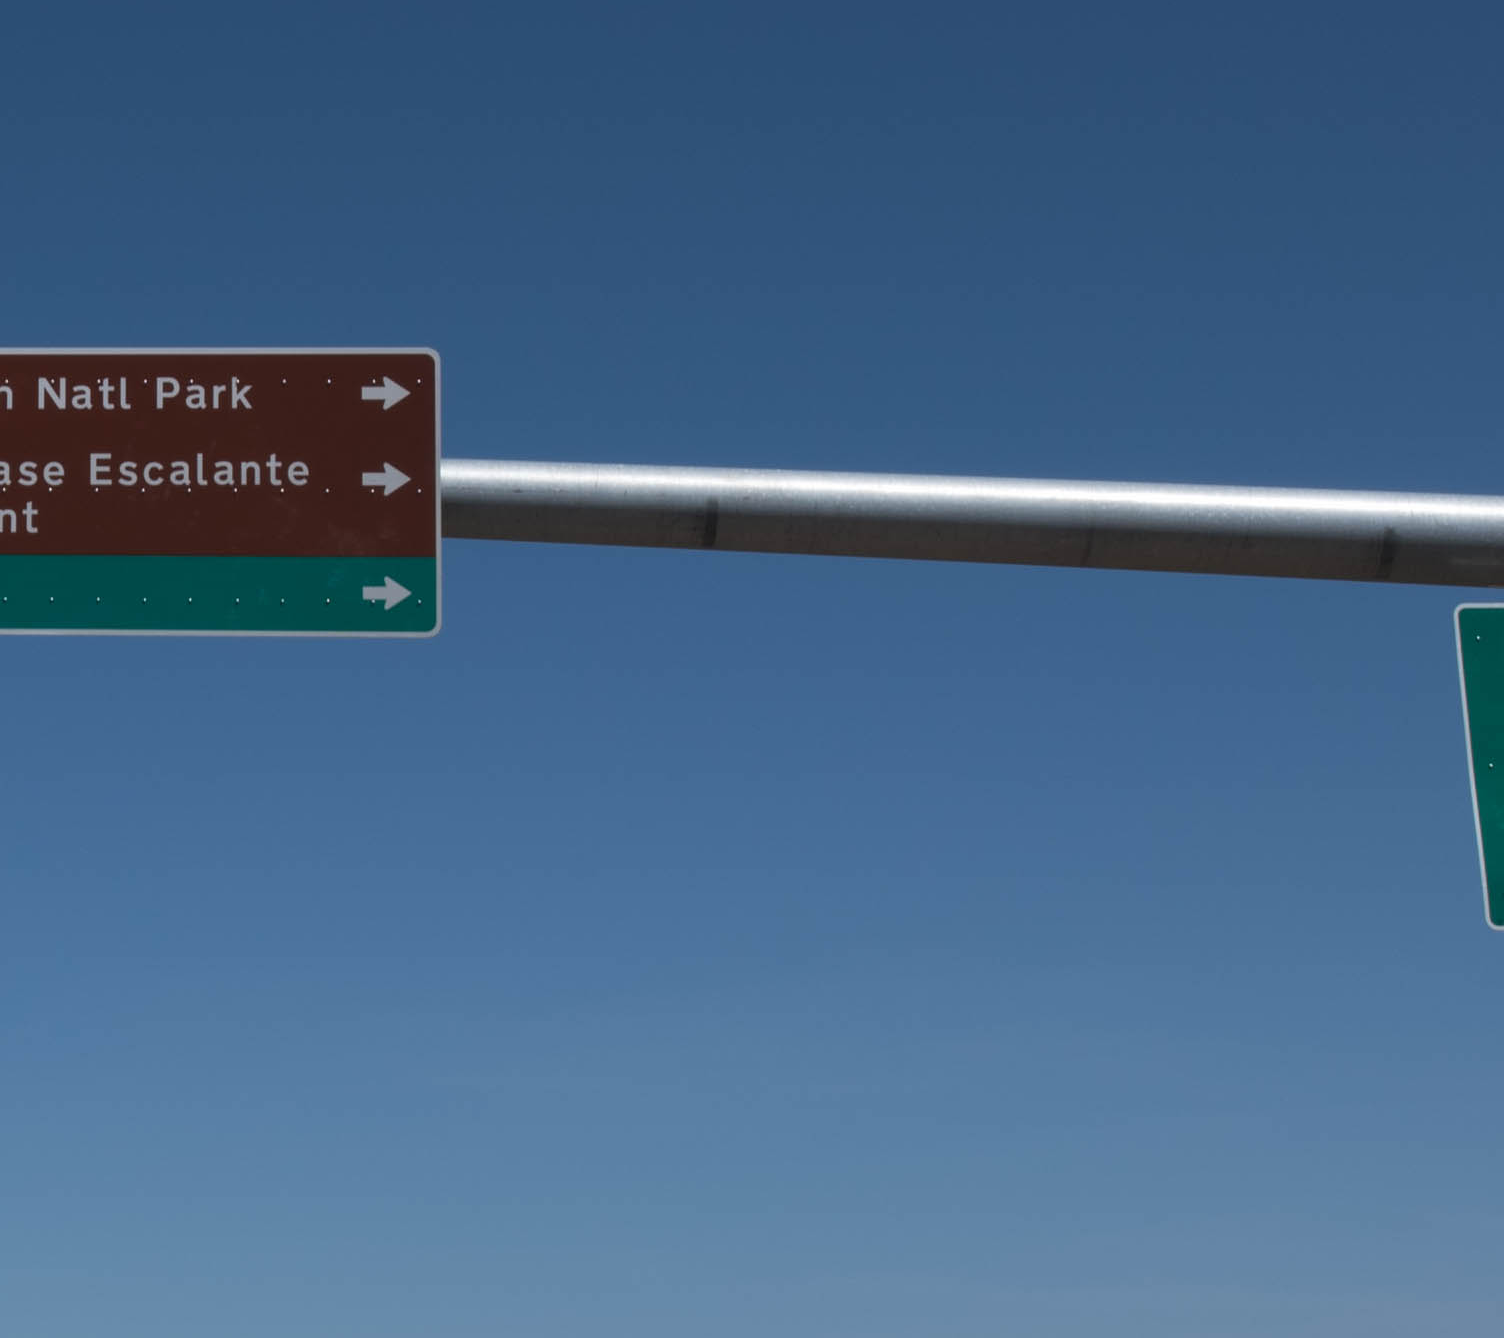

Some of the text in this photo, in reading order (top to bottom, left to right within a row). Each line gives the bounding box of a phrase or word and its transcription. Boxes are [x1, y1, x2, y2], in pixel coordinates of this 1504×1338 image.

[37, 376, 132, 410] Natl
[155, 376, 254, 410] Park
[89, 452, 310, 487] Escalante
